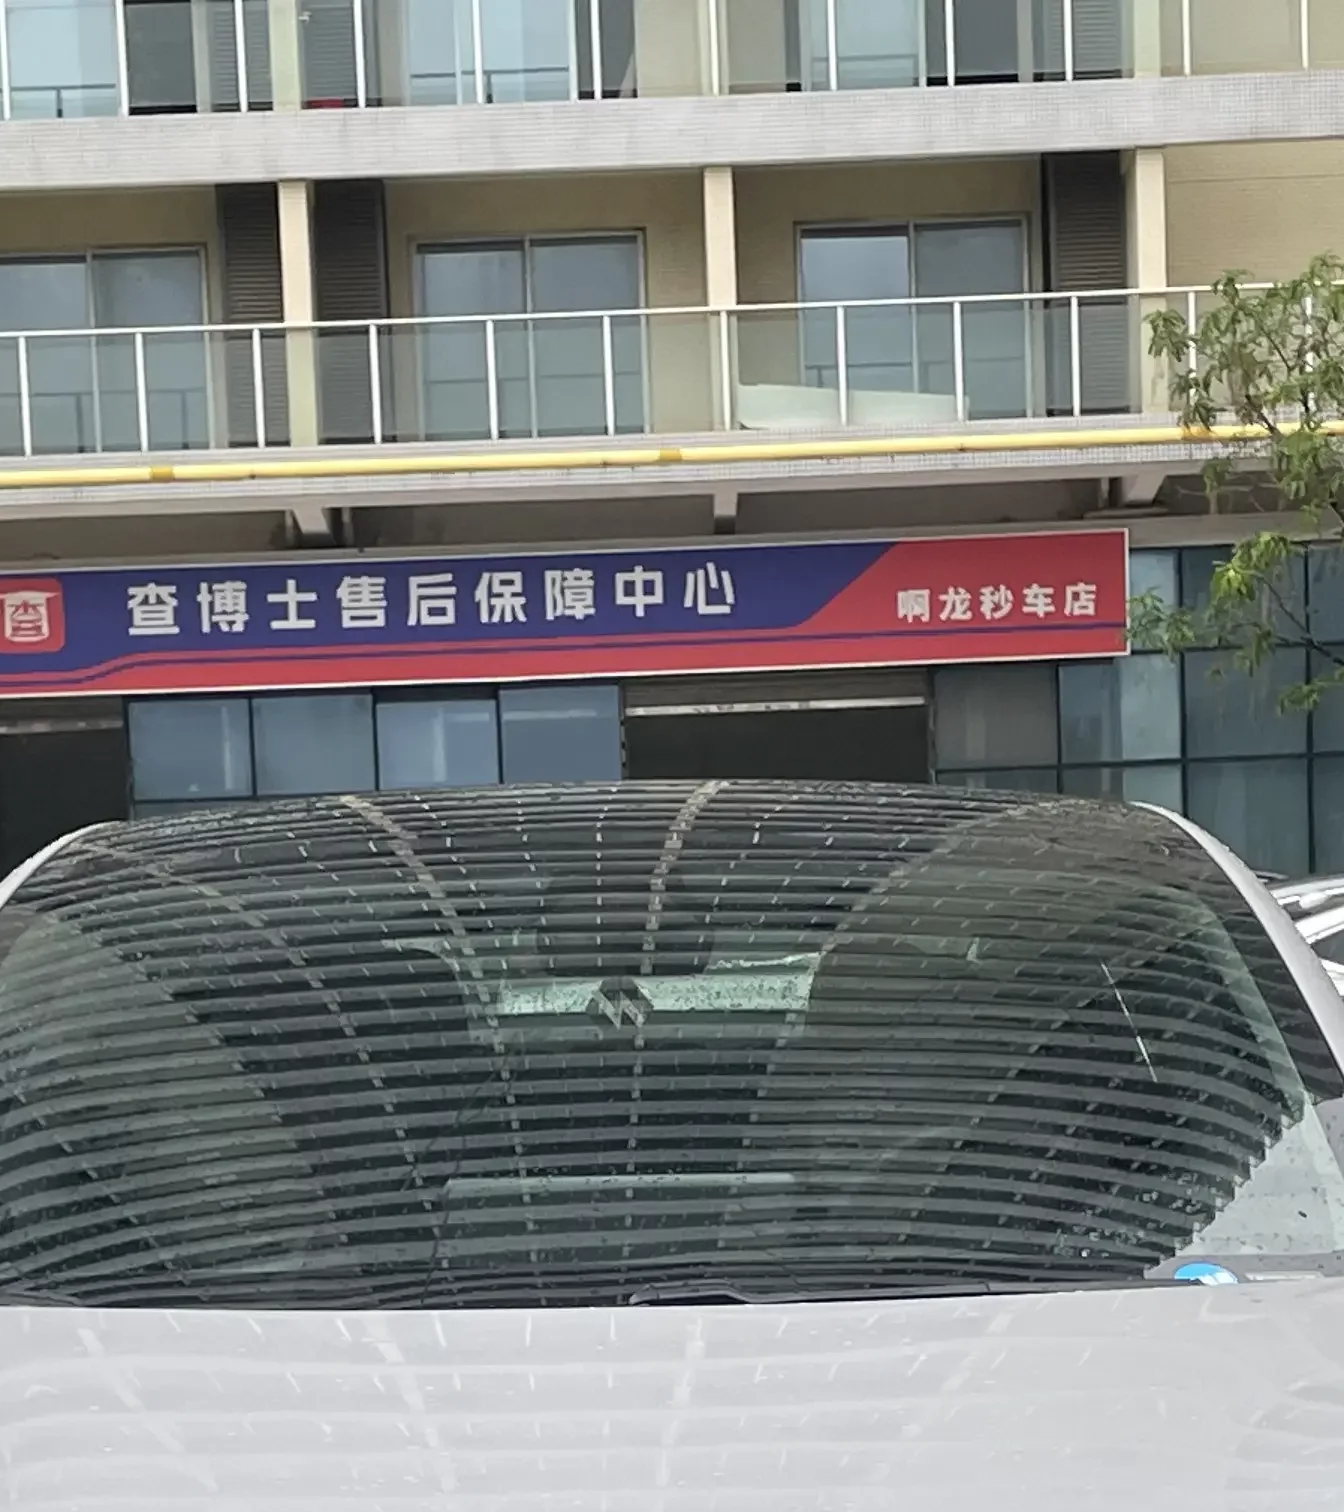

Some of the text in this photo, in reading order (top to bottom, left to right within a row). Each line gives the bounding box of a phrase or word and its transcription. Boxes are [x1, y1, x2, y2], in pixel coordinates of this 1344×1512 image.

[126, 562, 737, 636] 查博士售后保障中心
[897, 583, 1097, 623] 啊龙秒车店
